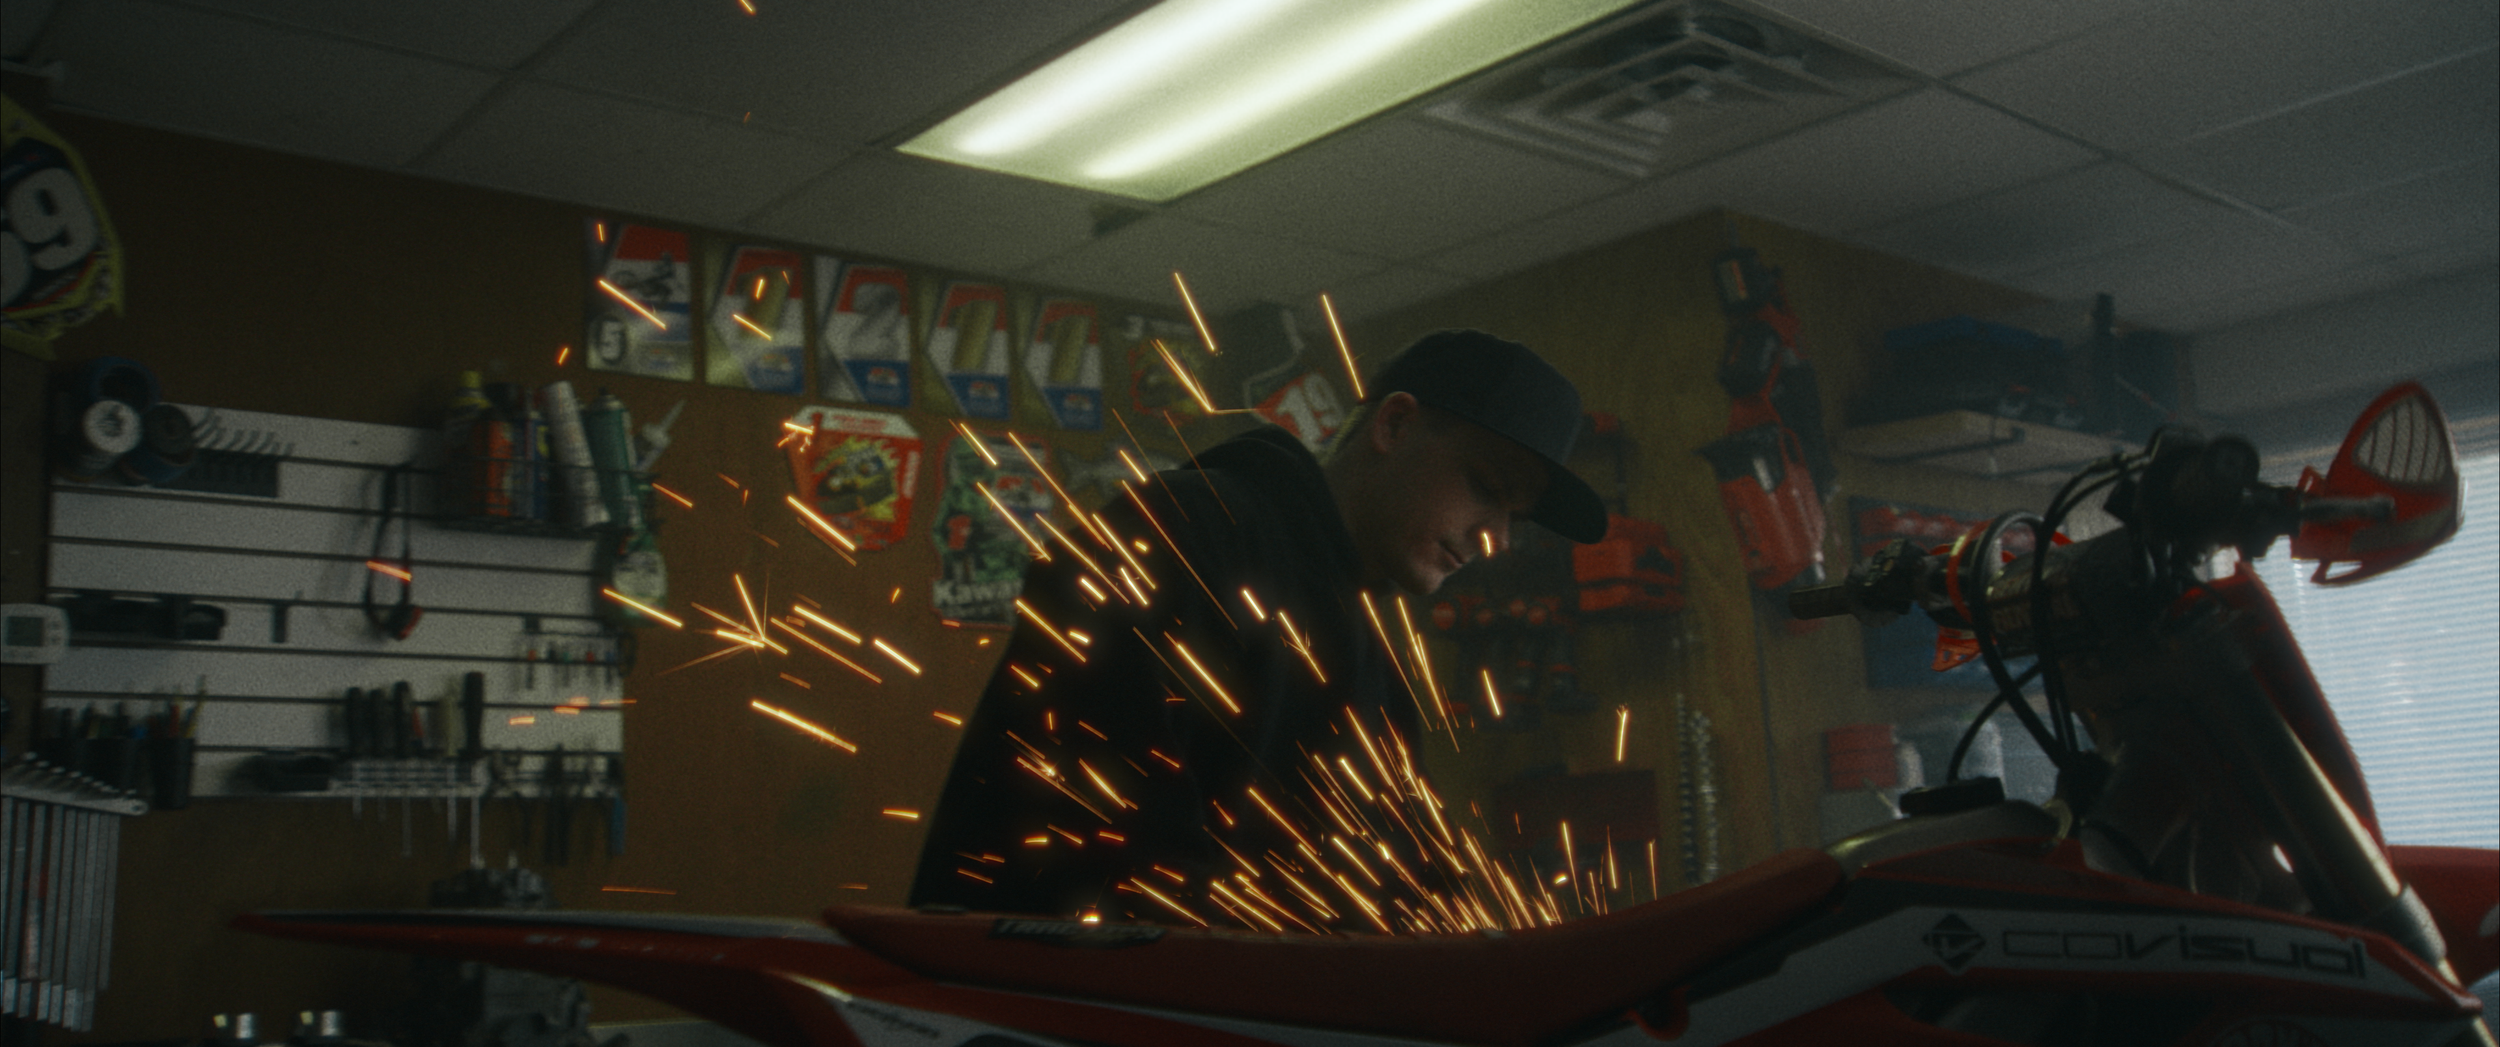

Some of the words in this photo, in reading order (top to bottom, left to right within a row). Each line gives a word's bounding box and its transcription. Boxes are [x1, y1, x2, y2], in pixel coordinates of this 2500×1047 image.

[600, 321, 624, 361] 5
[850, 281, 902, 359] 2
[946, 299, 998, 371] 1
[1041, 314, 1091, 383] 1
[1276, 373, 1345, 453] 19
[2001, 925, 2367, 977] covisual
